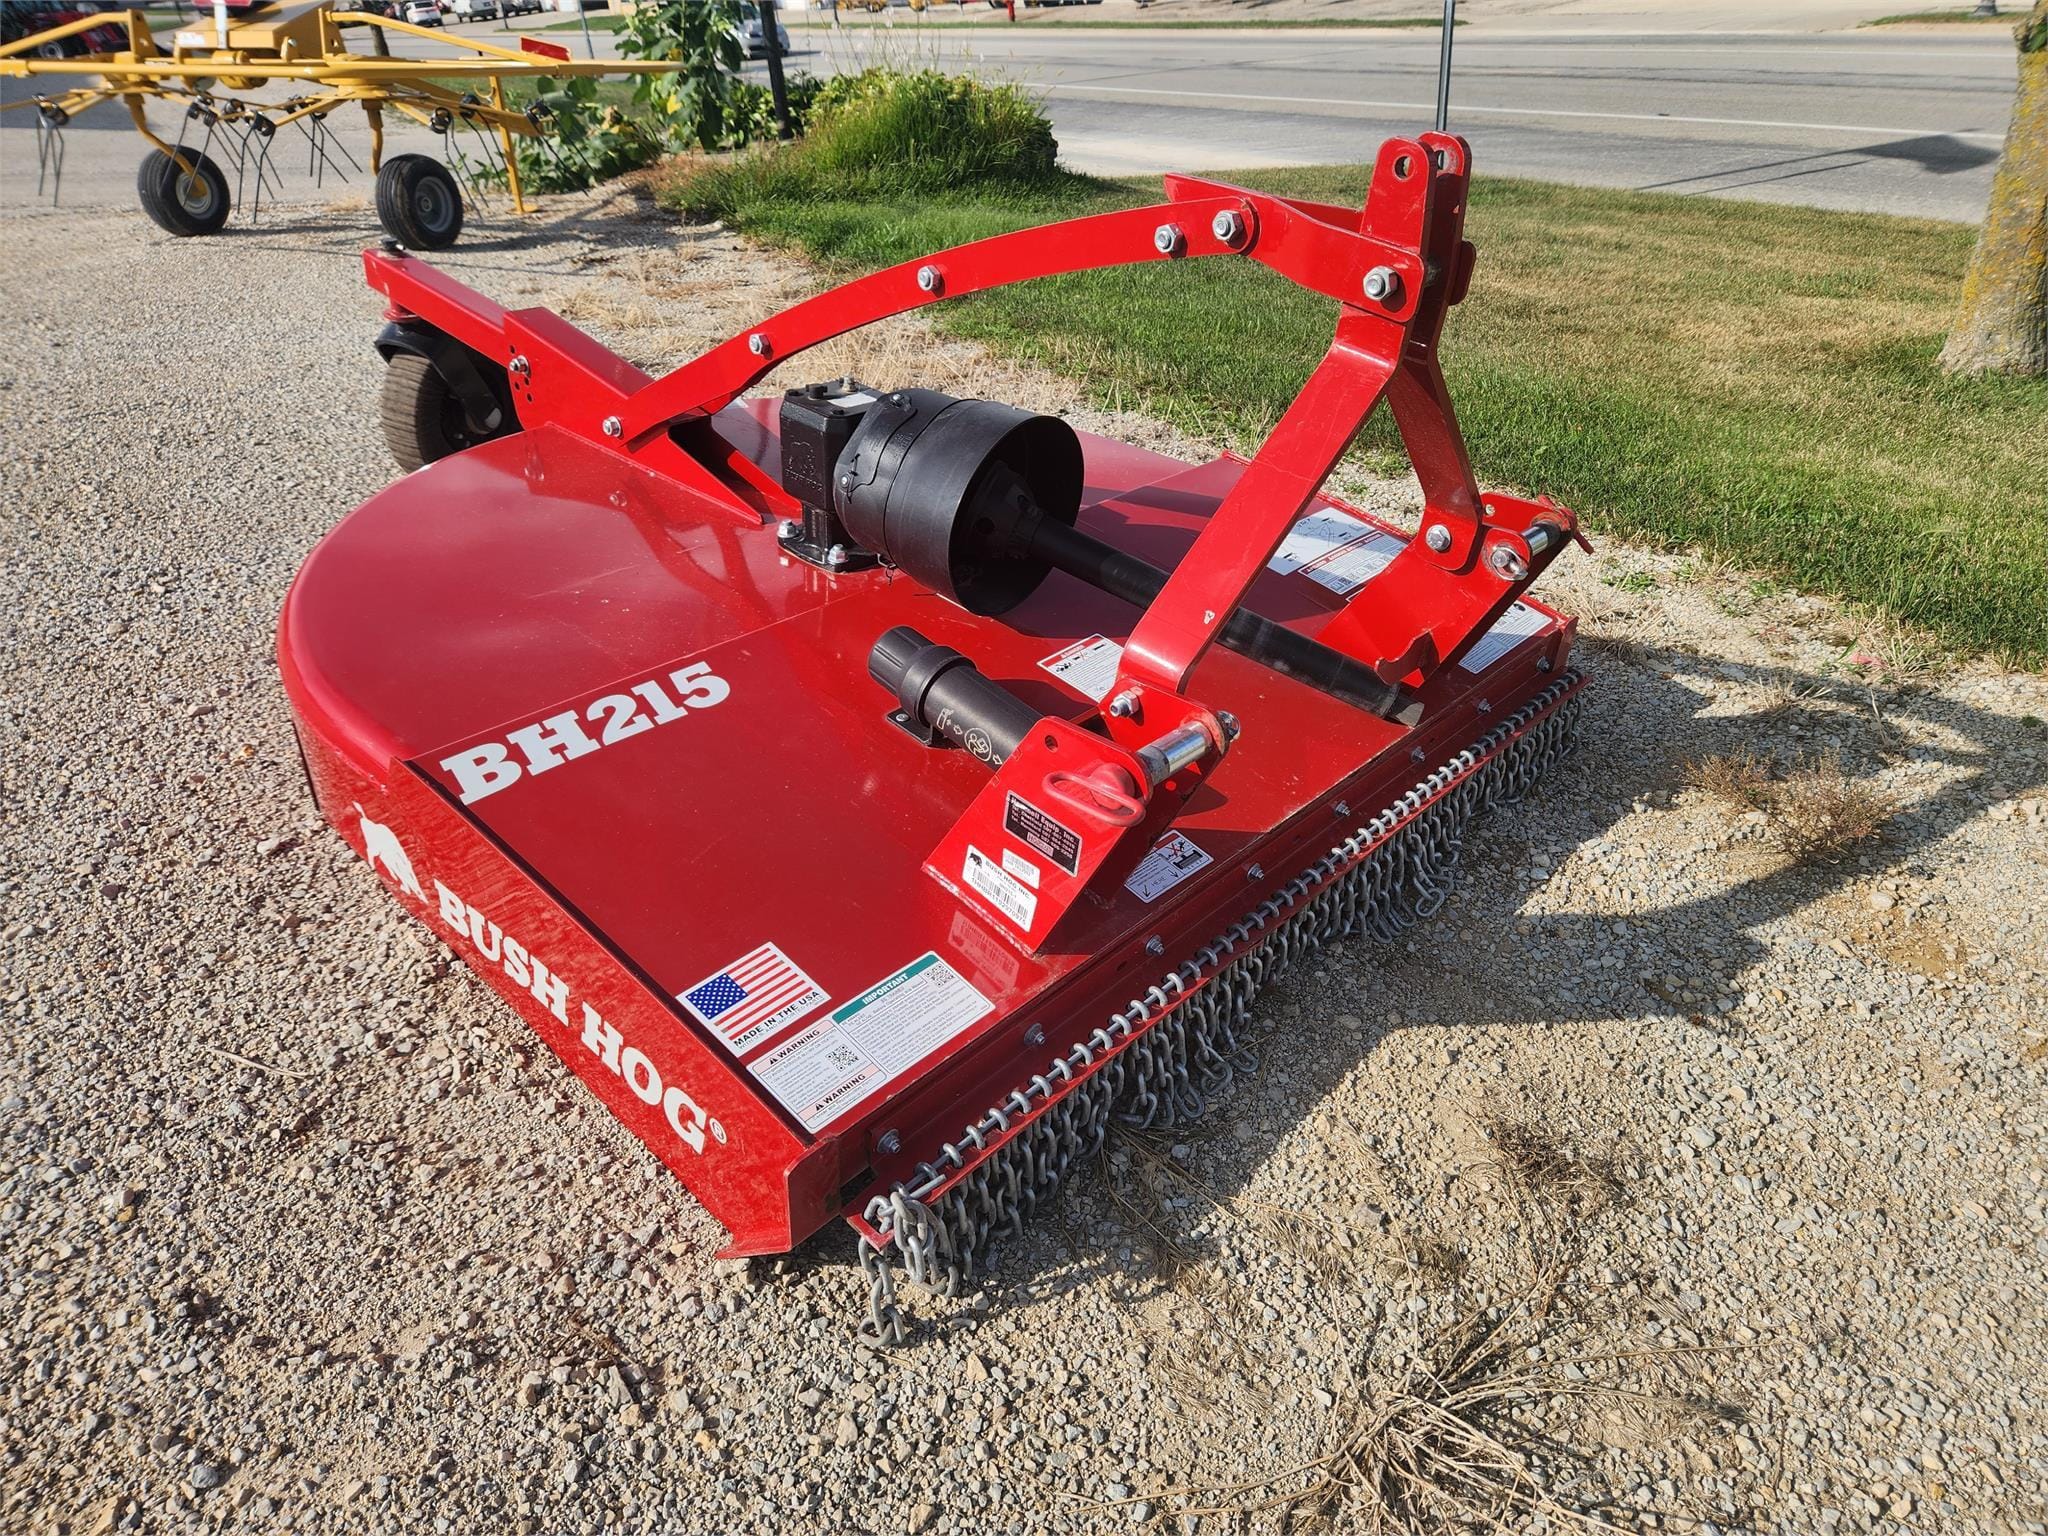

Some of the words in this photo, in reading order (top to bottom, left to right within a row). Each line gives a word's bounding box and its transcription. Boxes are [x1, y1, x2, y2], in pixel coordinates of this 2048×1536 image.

[439, 661, 730, 805] BH215
[985, 860, 1002, 877] BUSH
[1003, 874, 1017, 889] HOG
[434, 879, 569, 1027] BUSH
[862, 972, 909, 1005] IMPORTANT
[733, 1026, 763, 1046] MADE
[762, 1017, 777, 1027] IN
[777, 1004, 797, 1018] THE
[798, 991, 818, 1005] USA
[776, 1029, 820, 1058] WARNING
[823, 1073, 865, 1105] WARNING
